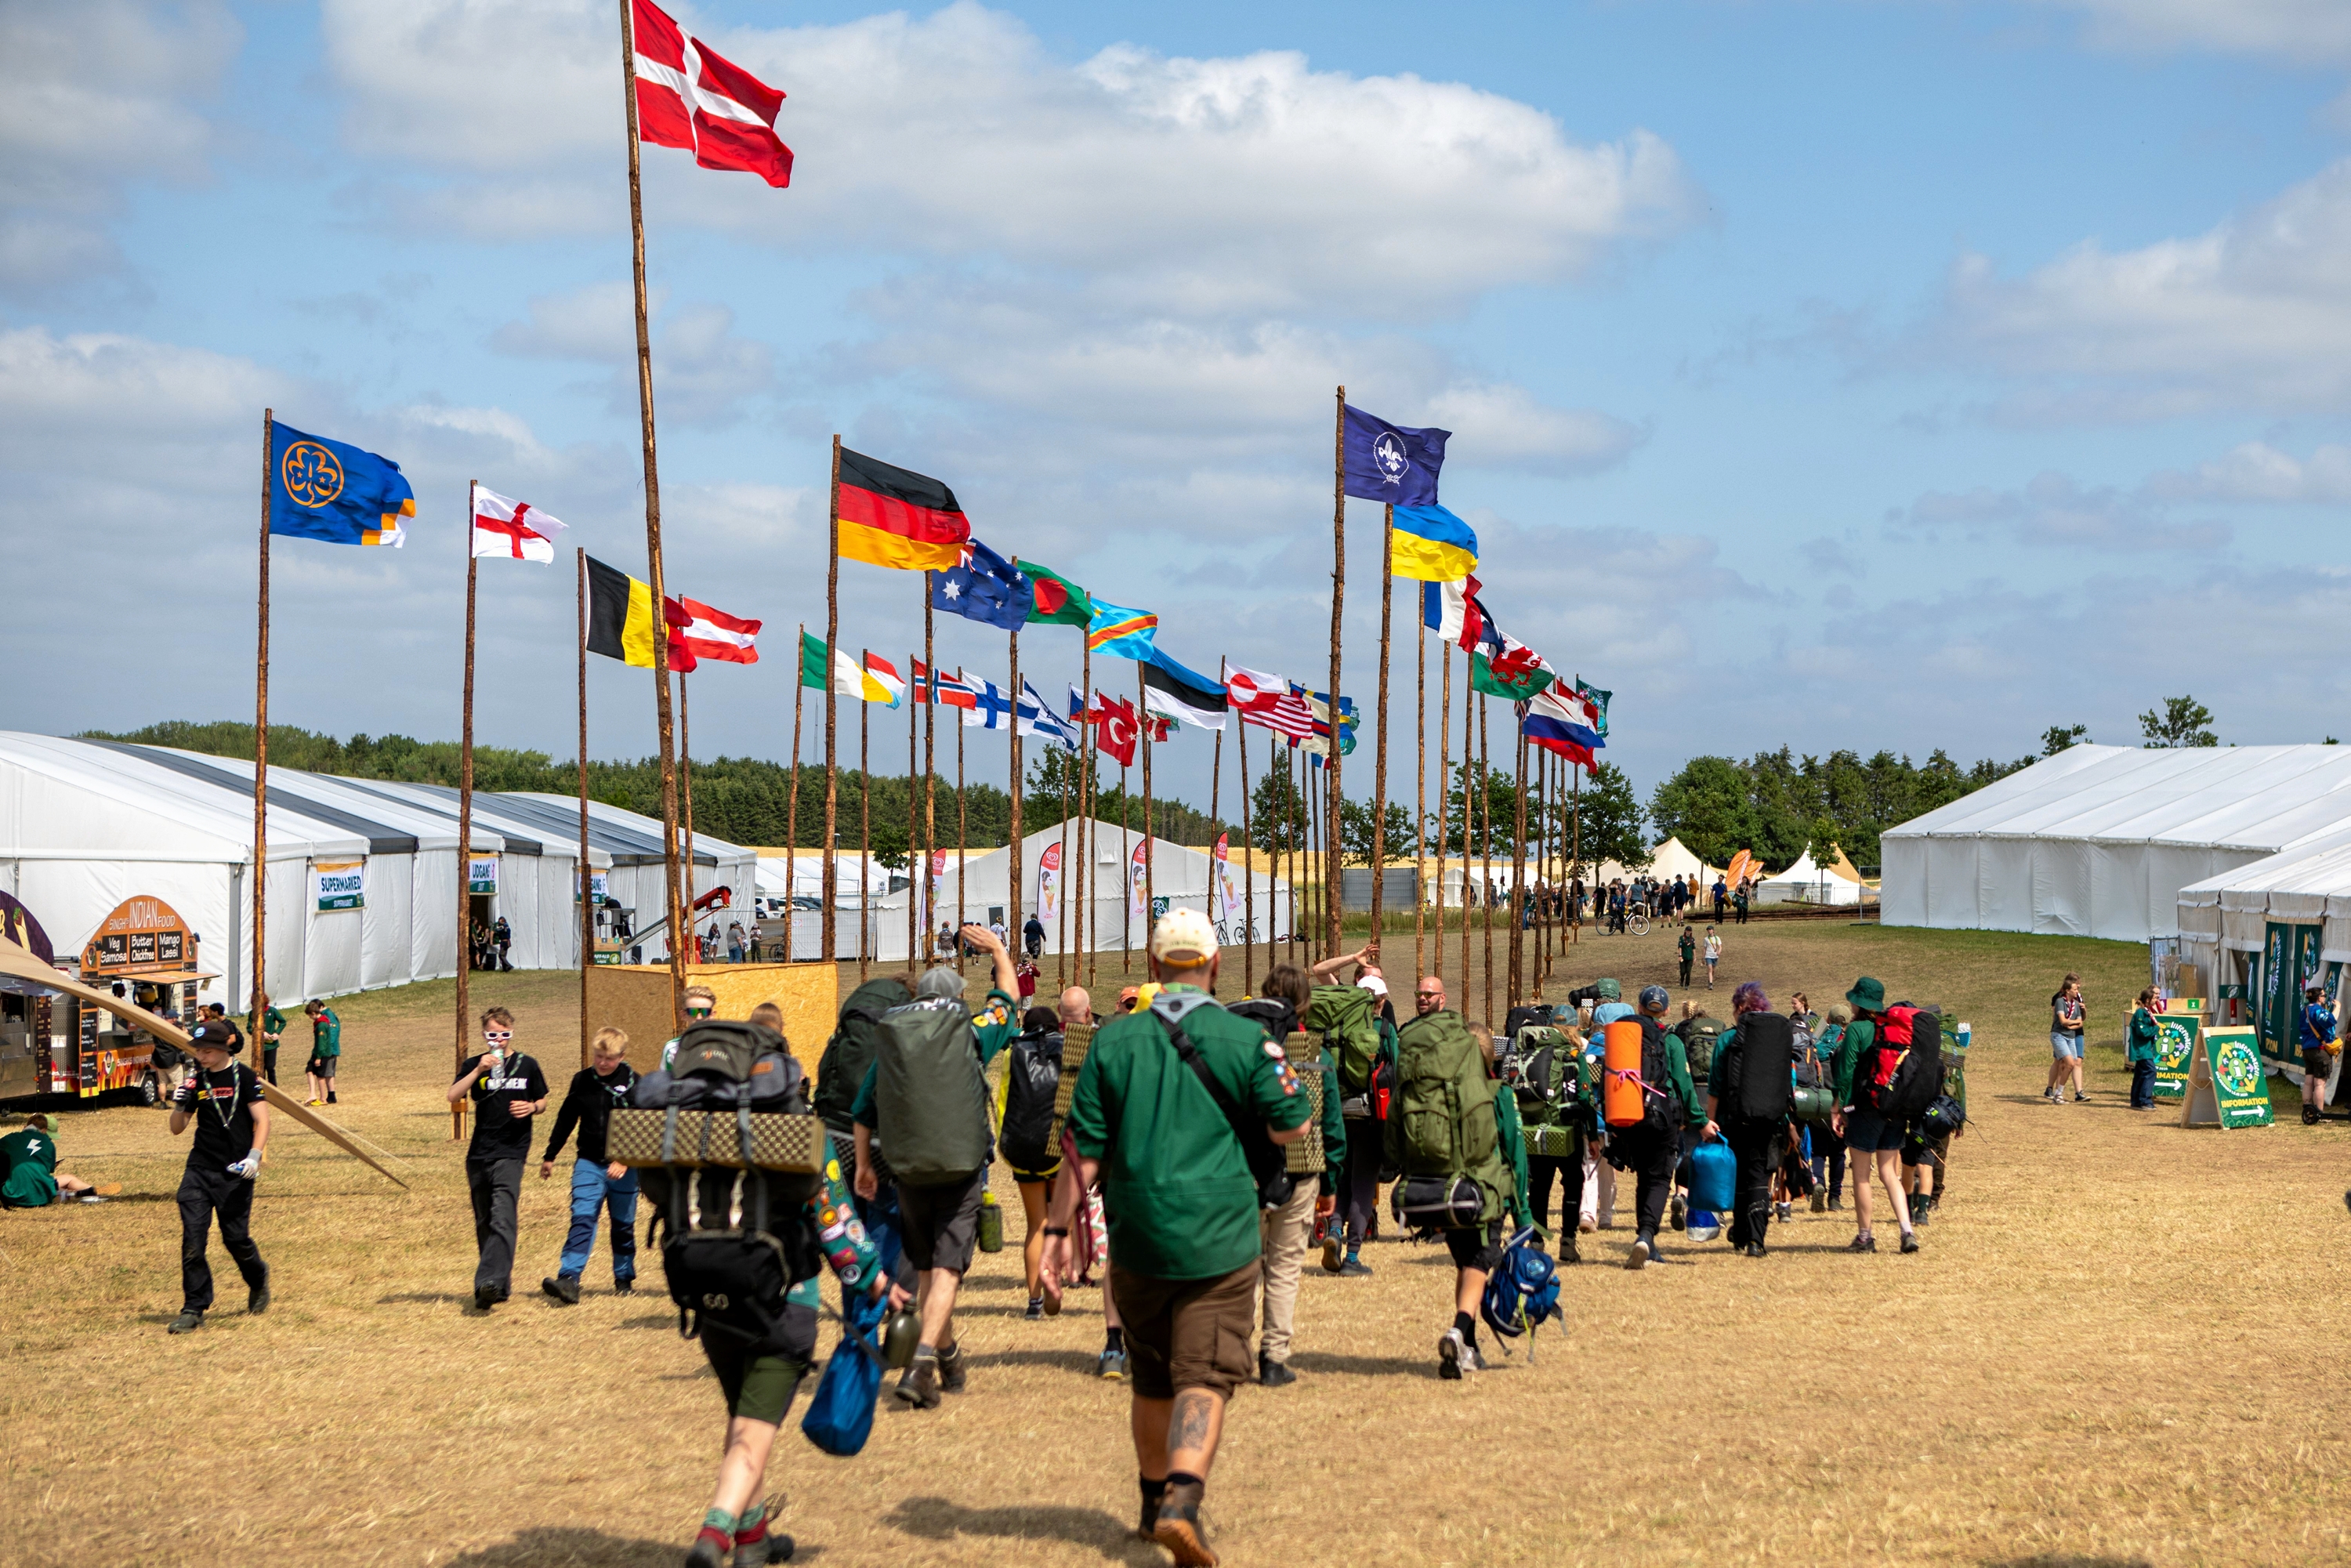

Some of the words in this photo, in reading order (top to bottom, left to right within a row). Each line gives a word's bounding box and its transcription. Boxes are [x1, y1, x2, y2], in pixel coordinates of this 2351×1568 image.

[321, 875, 361, 893] SUPERMARKED
[333, 898, 353, 907] SUPERMARKET
[109, 918, 129, 931] SINGH'S
[129, 901, 158, 929] INDIAN
[158, 915, 175, 928] FOOD
[109, 937, 120, 951] Veg
[132, 936, 154, 947] Butter
[159, 934, 180, 947] Mango
[101, 952, 127, 963] Samosa
[132, 949, 155, 961] Chickfree
[161, 947, 179, 958] Lassi
[132, 1033, 154, 1044] WELCOME
[2171, 1021, 2192, 1056] Information
[2234, 1041, 2259, 1077] Information
[2221, 1097, 2269, 1108] INFORMATION
